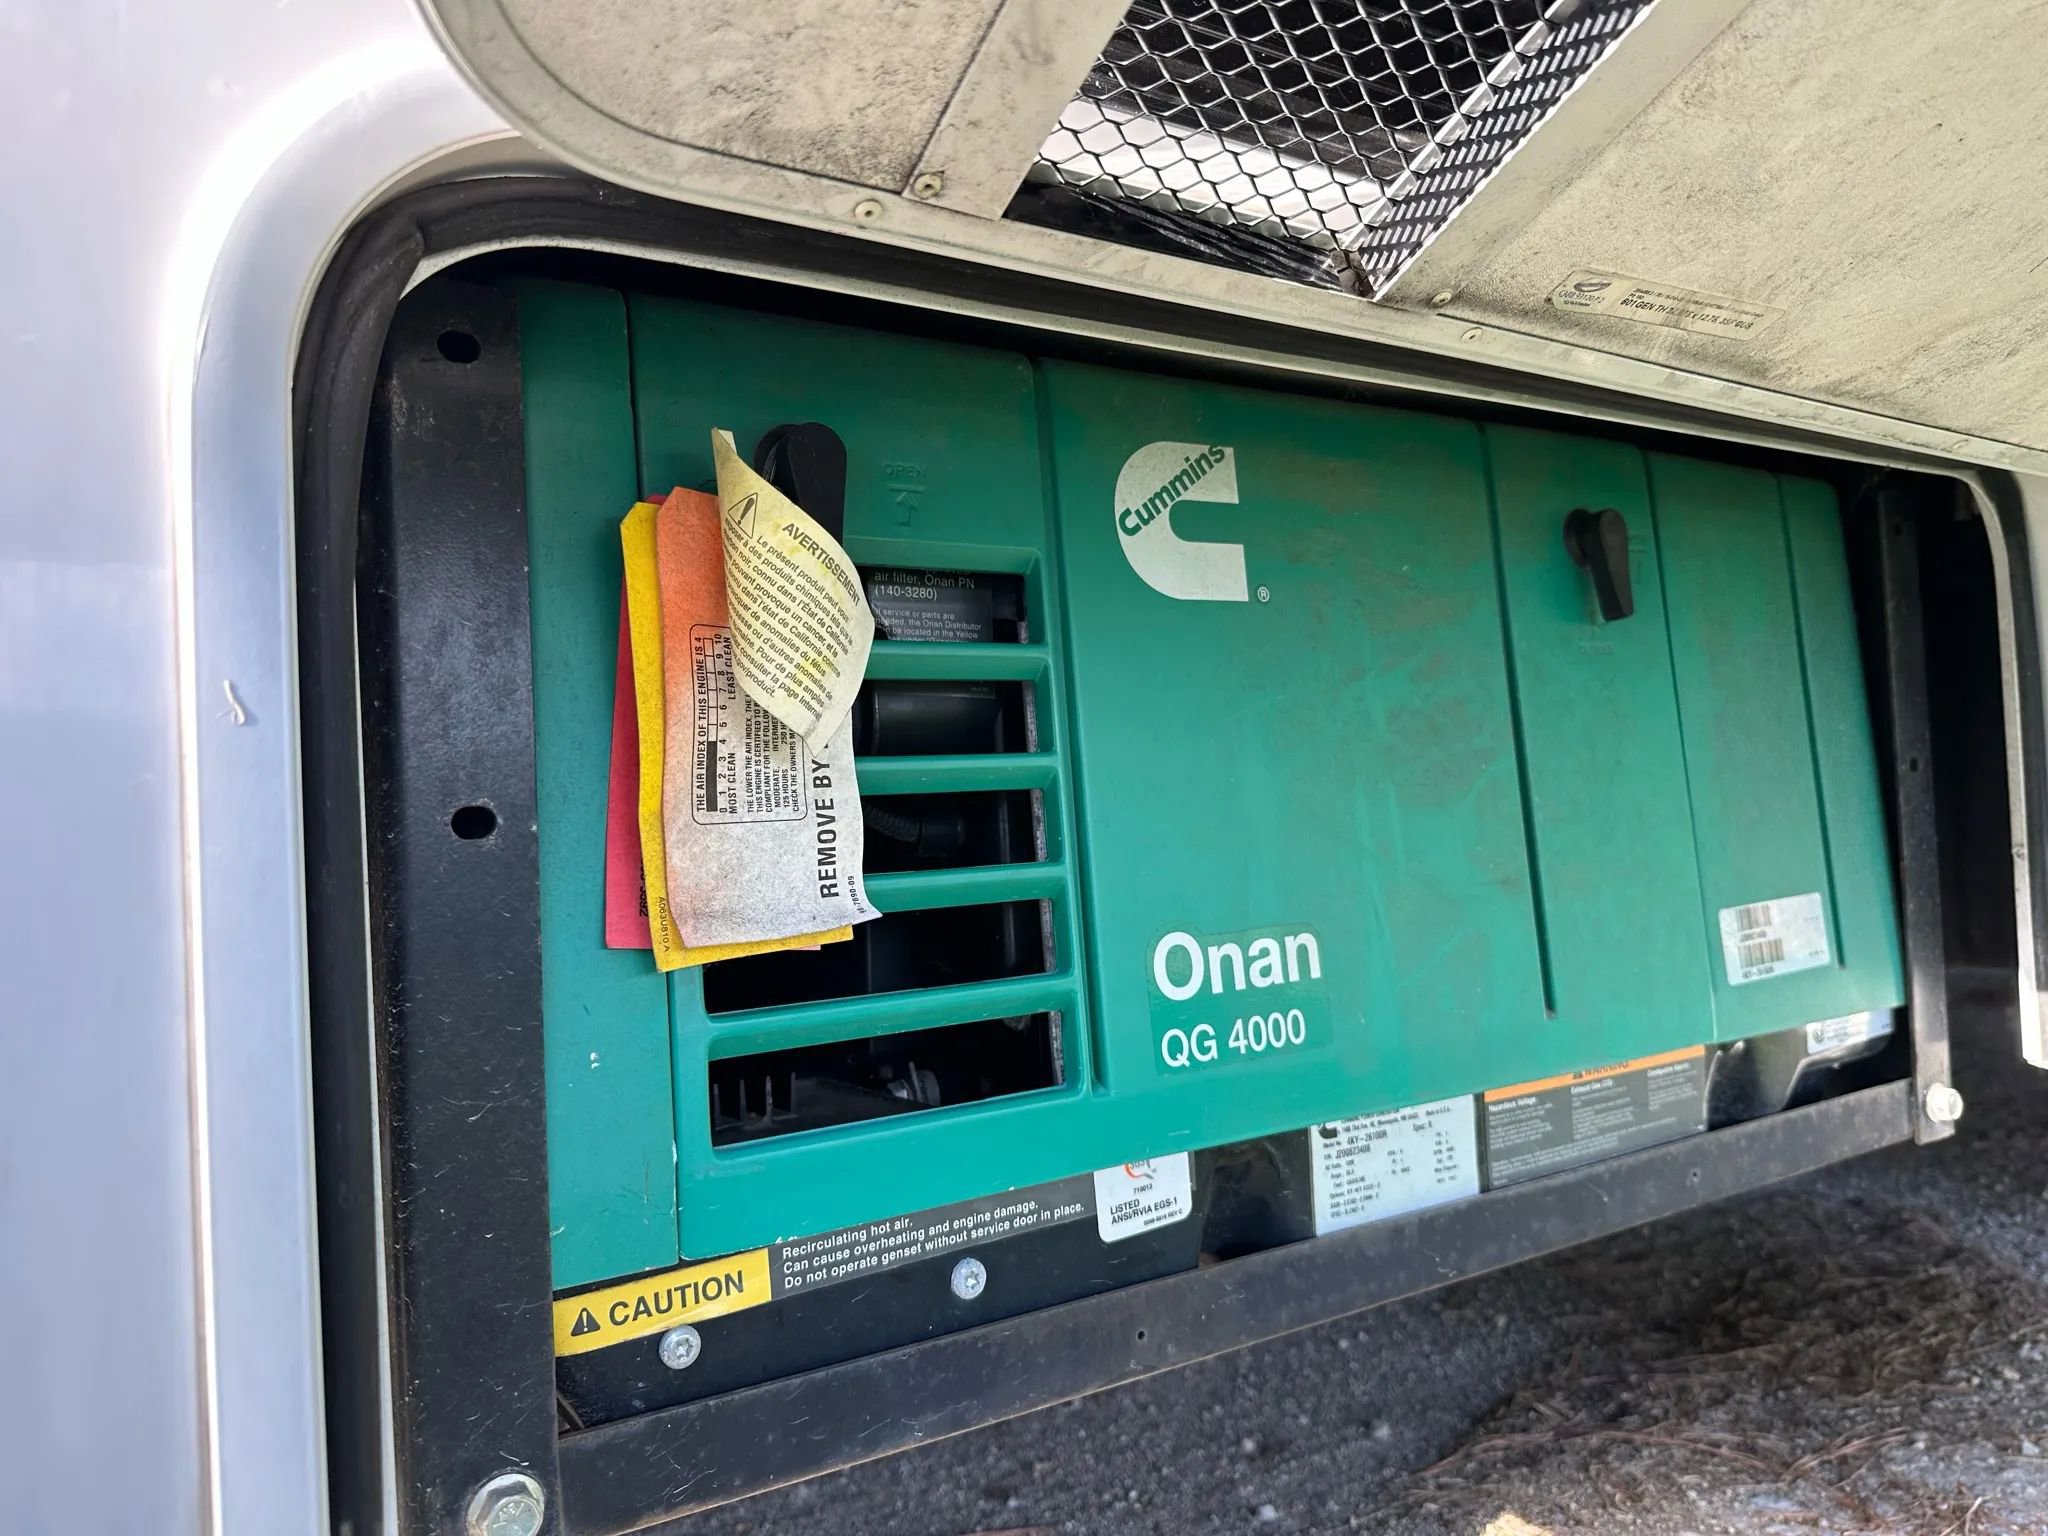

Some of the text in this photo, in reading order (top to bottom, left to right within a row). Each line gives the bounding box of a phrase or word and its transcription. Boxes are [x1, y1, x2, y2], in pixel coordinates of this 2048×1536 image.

[1635, 300, 1656, 311] GEN
[1119, 445, 1225, 537] Cummins
[757, 536, 768, 548] Le
[767, 544, 800, 574] présent
[797, 569, 828, 595] produit
[823, 591, 839, 608] peut
[837, 604, 850, 622] vous
[782, 522, 860, 606] AVERTISSEMENT
[874, 570, 975, 590] air filter, Onan PN
[732, 558, 755, 586] pouvant
[754, 582, 791, 615] provoque
[791, 610, 802, 623] un
[802, 620, 826, 646] cancer,
[826, 641, 833, 651] et
[738, 550, 752, 568] noir,
[752, 564, 778, 587] connu
[776, 582, 798, 603] dans
[816, 616, 826, 628] de
[826, 624, 849, 656] Californie
[748, 544, 762, 560] des
[761, 557, 796, 586] produits
[795, 582, 831, 617] chimiques
[830, 613, 841, 628] tels
[874, 585, 938, 601] (140-3280)
[741, 584, 842, 678] dans l'état de Californie comme
[882, 608, 955, 620] service or parts are
[892, 626, 902, 635] be
[904, 627, 932, 637] located
[933, 629, 941, 637] in
[942, 629, 954, 638] the
[955, 630, 978, 640] Yellow
[908, 618, 982, 631] the Onan Distributor
[695, 646, 703, 655] IS
[714, 634, 722, 645] 10
[750, 610, 762, 622] de
[760, 618, 800, 653] anomalies
[800, 649, 810, 662] du
[696, 659, 706, 694] ENGINE
[723, 637, 736, 700] LEAST CLEAN
[740, 646, 770, 677] consulter
[770, 673, 780, 686] la
[778, 680, 800, 700] page
[752, 628, 764, 640] ou
[763, 634, 795, 666] d'autres
[794, 662, 828, 695] anomalies
[826, 690, 834, 702] de
[756, 646, 776, 665] Pour
[775, 662, 786, 674] de
[785, 670, 804, 688] plus
[802, 684, 825, 708] amples
[698, 698, 706, 721] THIS
[698, 724, 706, 737] OF
[753, 710, 760, 718] TO
[697, 740, 705, 770] INDEX
[753, 721, 761, 758] CERTIFIED
[697, 793, 705, 812] THE
[728, 753, 737, 814] MOST CLEAN
[754, 768, 762, 795] ENGINE
[763, 770, 773, 813] COMPLIANT
[791, 789, 799, 812] CHECK
[755, 797, 763, 813] THIS
[811, 758, 840, 899] REMOVE BY
[1154, 932, 1321, 1000] Onan
[1161, 1008, 1306, 1068] QG 4000
[1110, 1198, 1140, 1215] LISTED
[1111, 1196, 1178, 1225] ANSI/RVIA EGS-1
[782, 1217, 913, 1260] Recirculating hot air.
[784, 1200, 1038, 1274] Can cause overheating and engine damage.
[784, 1202, 1084, 1289] Do not operate genset without service door in place.
[609, 1270, 744, 1326] CAUTION
